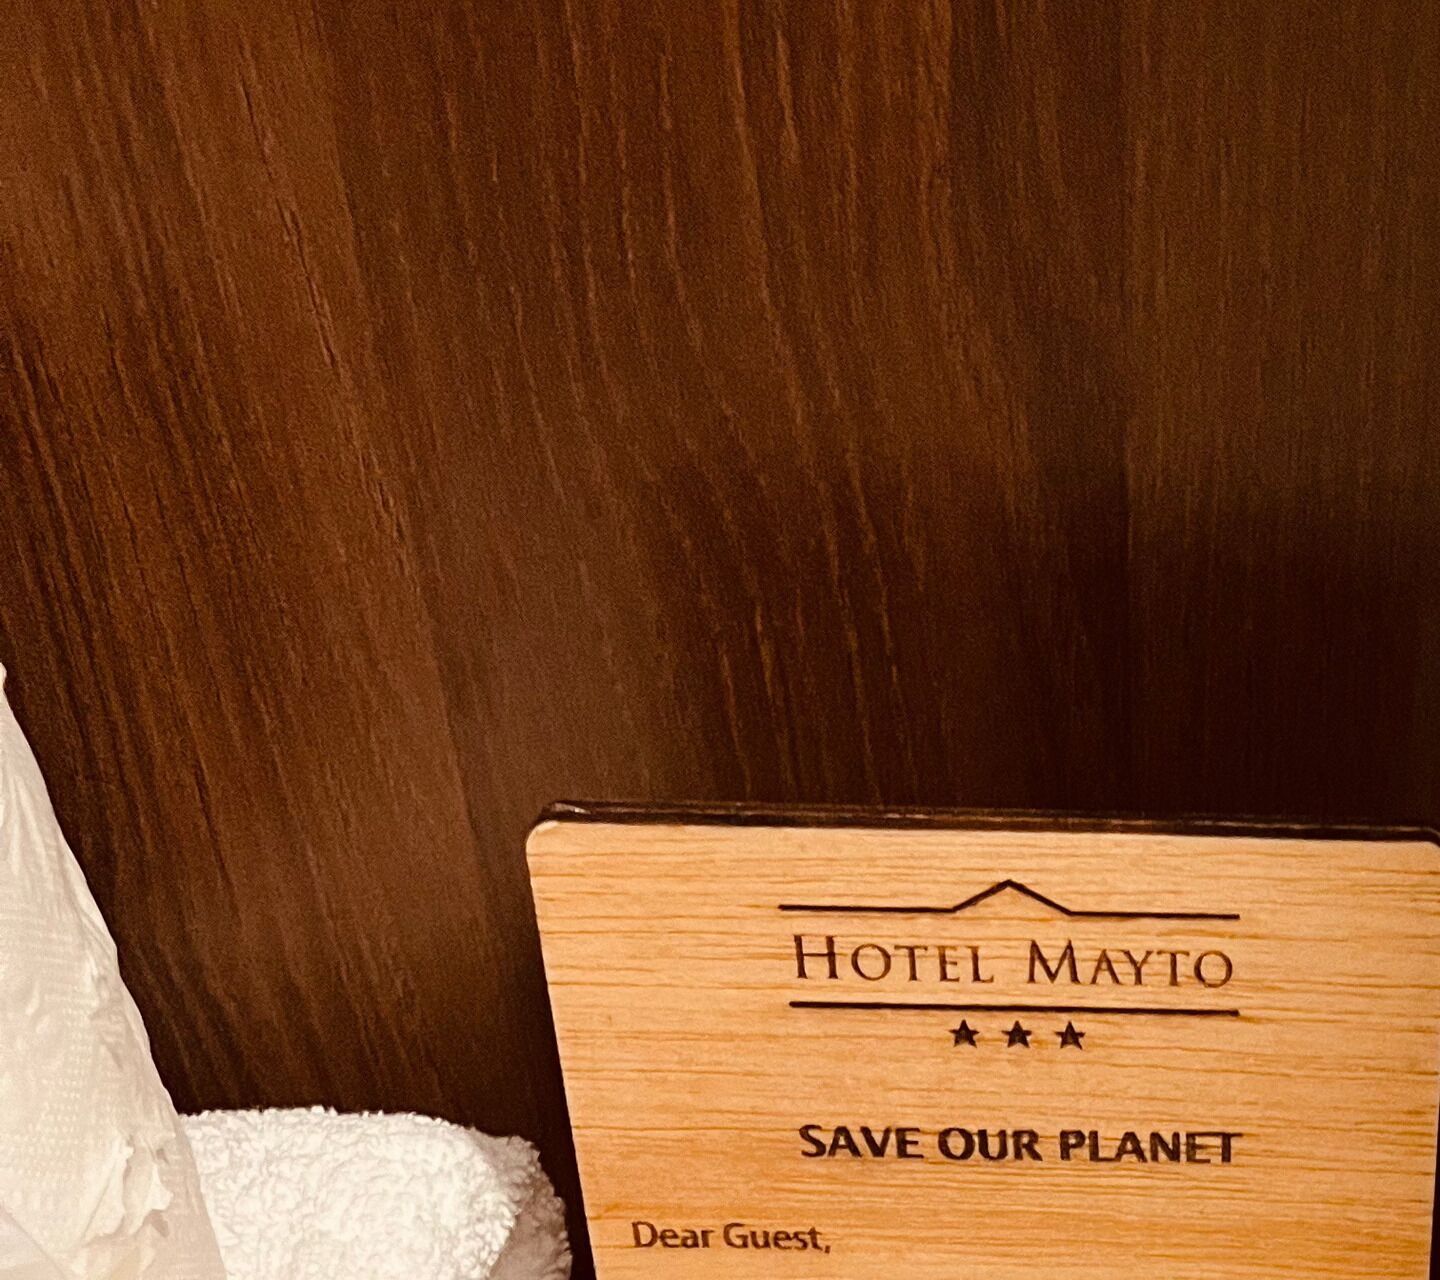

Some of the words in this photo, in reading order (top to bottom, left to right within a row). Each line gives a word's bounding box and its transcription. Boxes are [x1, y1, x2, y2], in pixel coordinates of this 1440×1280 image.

[793, 933, 995, 983] HOTEL
[1027, 938, 1235, 990] MAYTO
[798, 1123, 924, 1160] SAVE
[937, 1126, 1043, 1162] OUR
[1059, 1129, 1245, 1165] PLANET
[631, 1221, 715, 1250] Dear
[722, 1222, 832, 1255] Guest,
